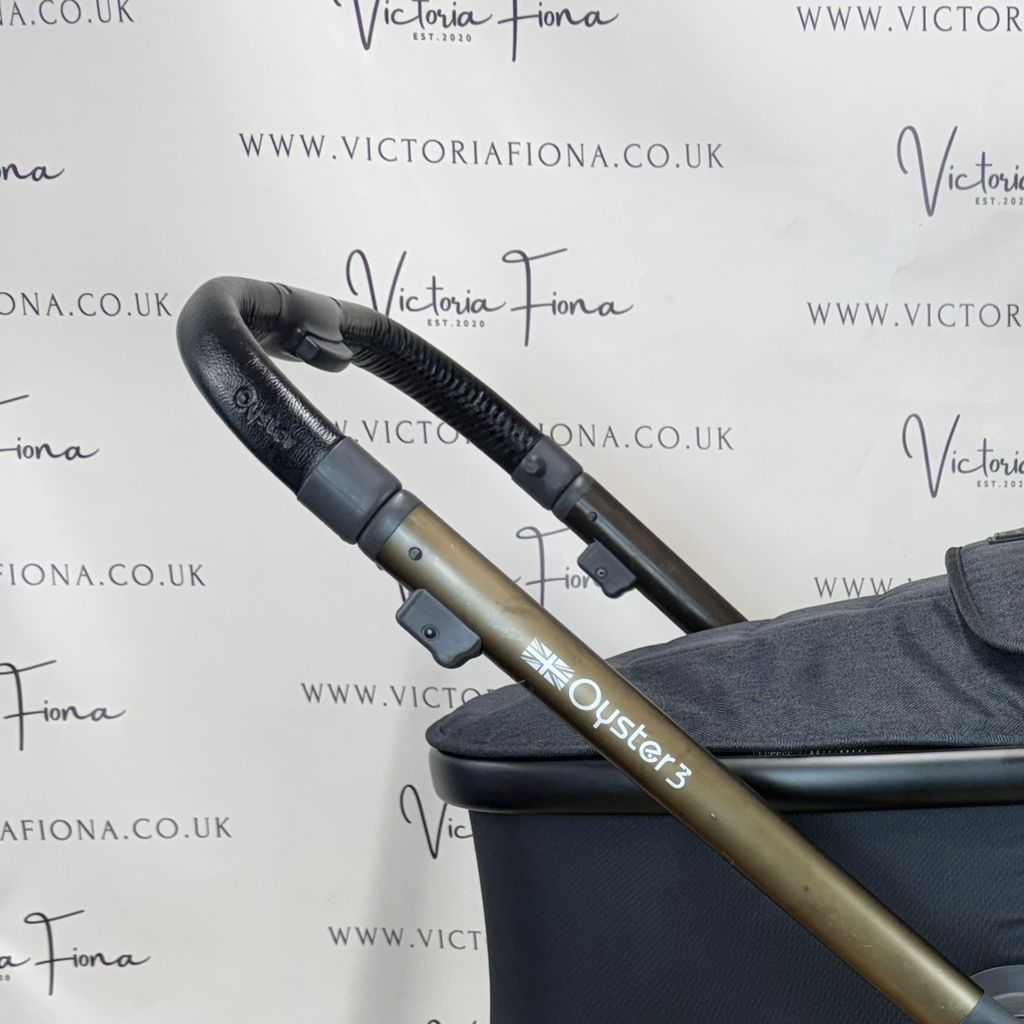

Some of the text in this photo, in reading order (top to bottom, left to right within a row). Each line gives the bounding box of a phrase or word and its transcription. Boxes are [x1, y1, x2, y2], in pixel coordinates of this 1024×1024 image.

[0, 0, 135, 26] A.CO.UK
[412, 31, 473, 43] EST.2020
[239, 133, 724, 169] WWW.VICTORIAFIONA.CO.UK
[346, 248, 634, 347] Victoria Fiona
[426, 318, 486, 329] EST.2020
[0, 661, 126, 751] Fiona
[569, 678, 676, 772] Oyster
[24, 910, 152, 995] Fiona
